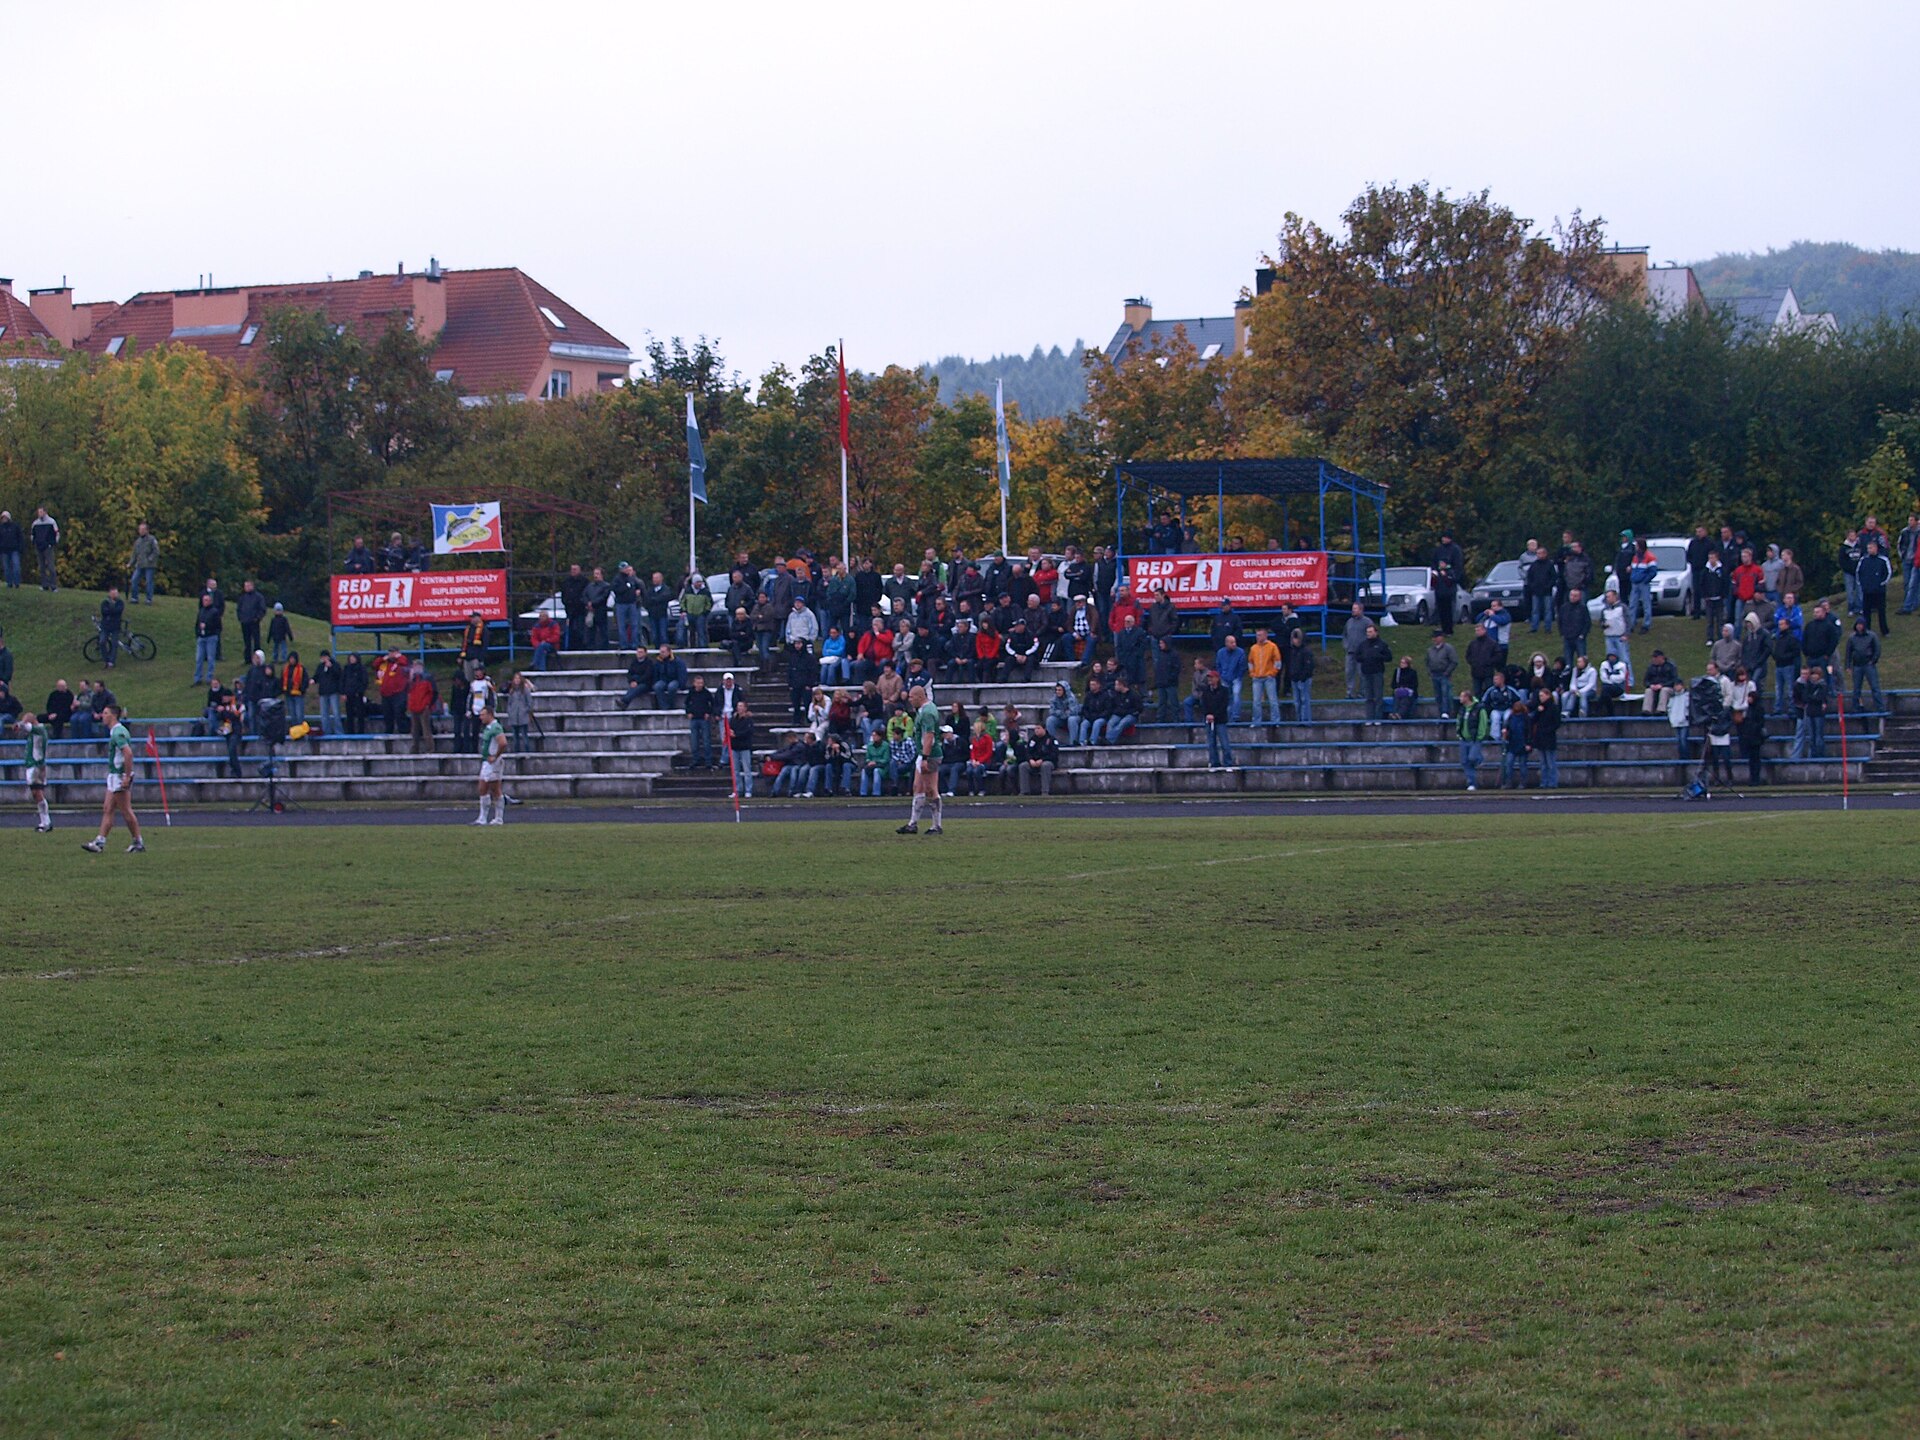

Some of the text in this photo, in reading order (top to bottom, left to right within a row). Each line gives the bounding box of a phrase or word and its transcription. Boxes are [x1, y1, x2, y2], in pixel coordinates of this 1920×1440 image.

[1230, 556, 1318, 567] CENTRUM SPRZEDAŻY
[1136, 561, 1174, 575] RED
[1243, 569, 1305, 578] SUPLEMENTÓW
[338, 578, 371, 593] RED
[420, 576, 454, 584] CENTRUM
[1136, 577, 1191, 593] ZONE
[1233, 581, 1268, 590] ODZIEŻY
[1269, 581, 1319, 590] SPORTOWEJ
[338, 594, 385, 610] ZONE
